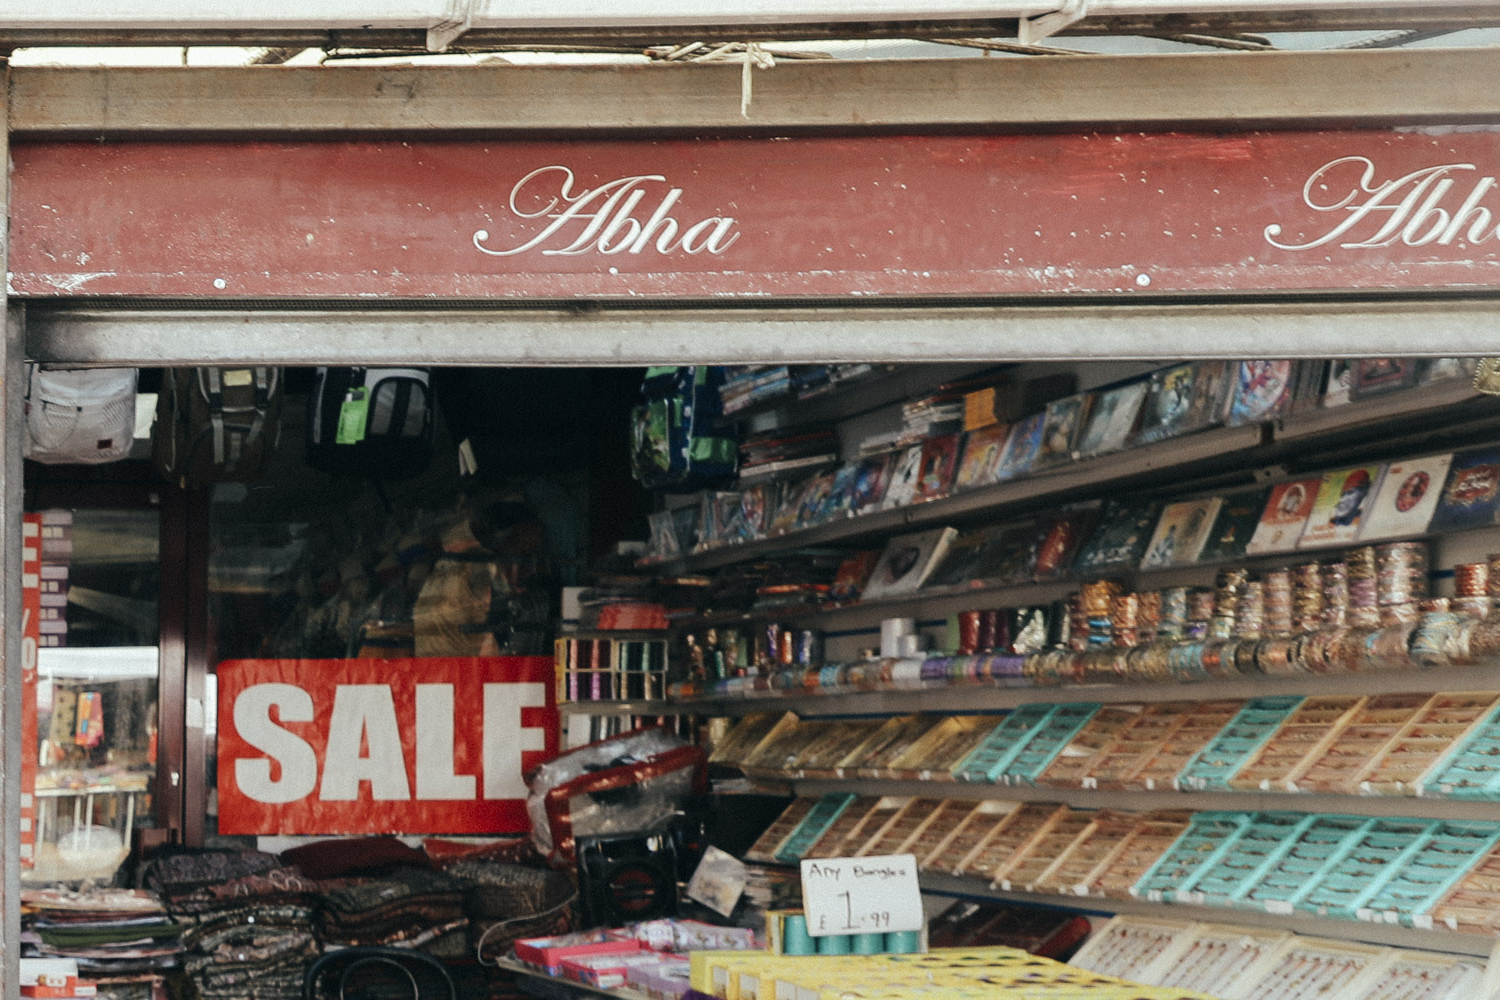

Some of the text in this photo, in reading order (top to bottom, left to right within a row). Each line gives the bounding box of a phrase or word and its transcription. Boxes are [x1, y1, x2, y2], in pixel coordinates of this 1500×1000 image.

[473, 165, 740, 256] Abha
[1264, 156, 1500, 250] Abh
[233, 682, 546, 803] SALE
